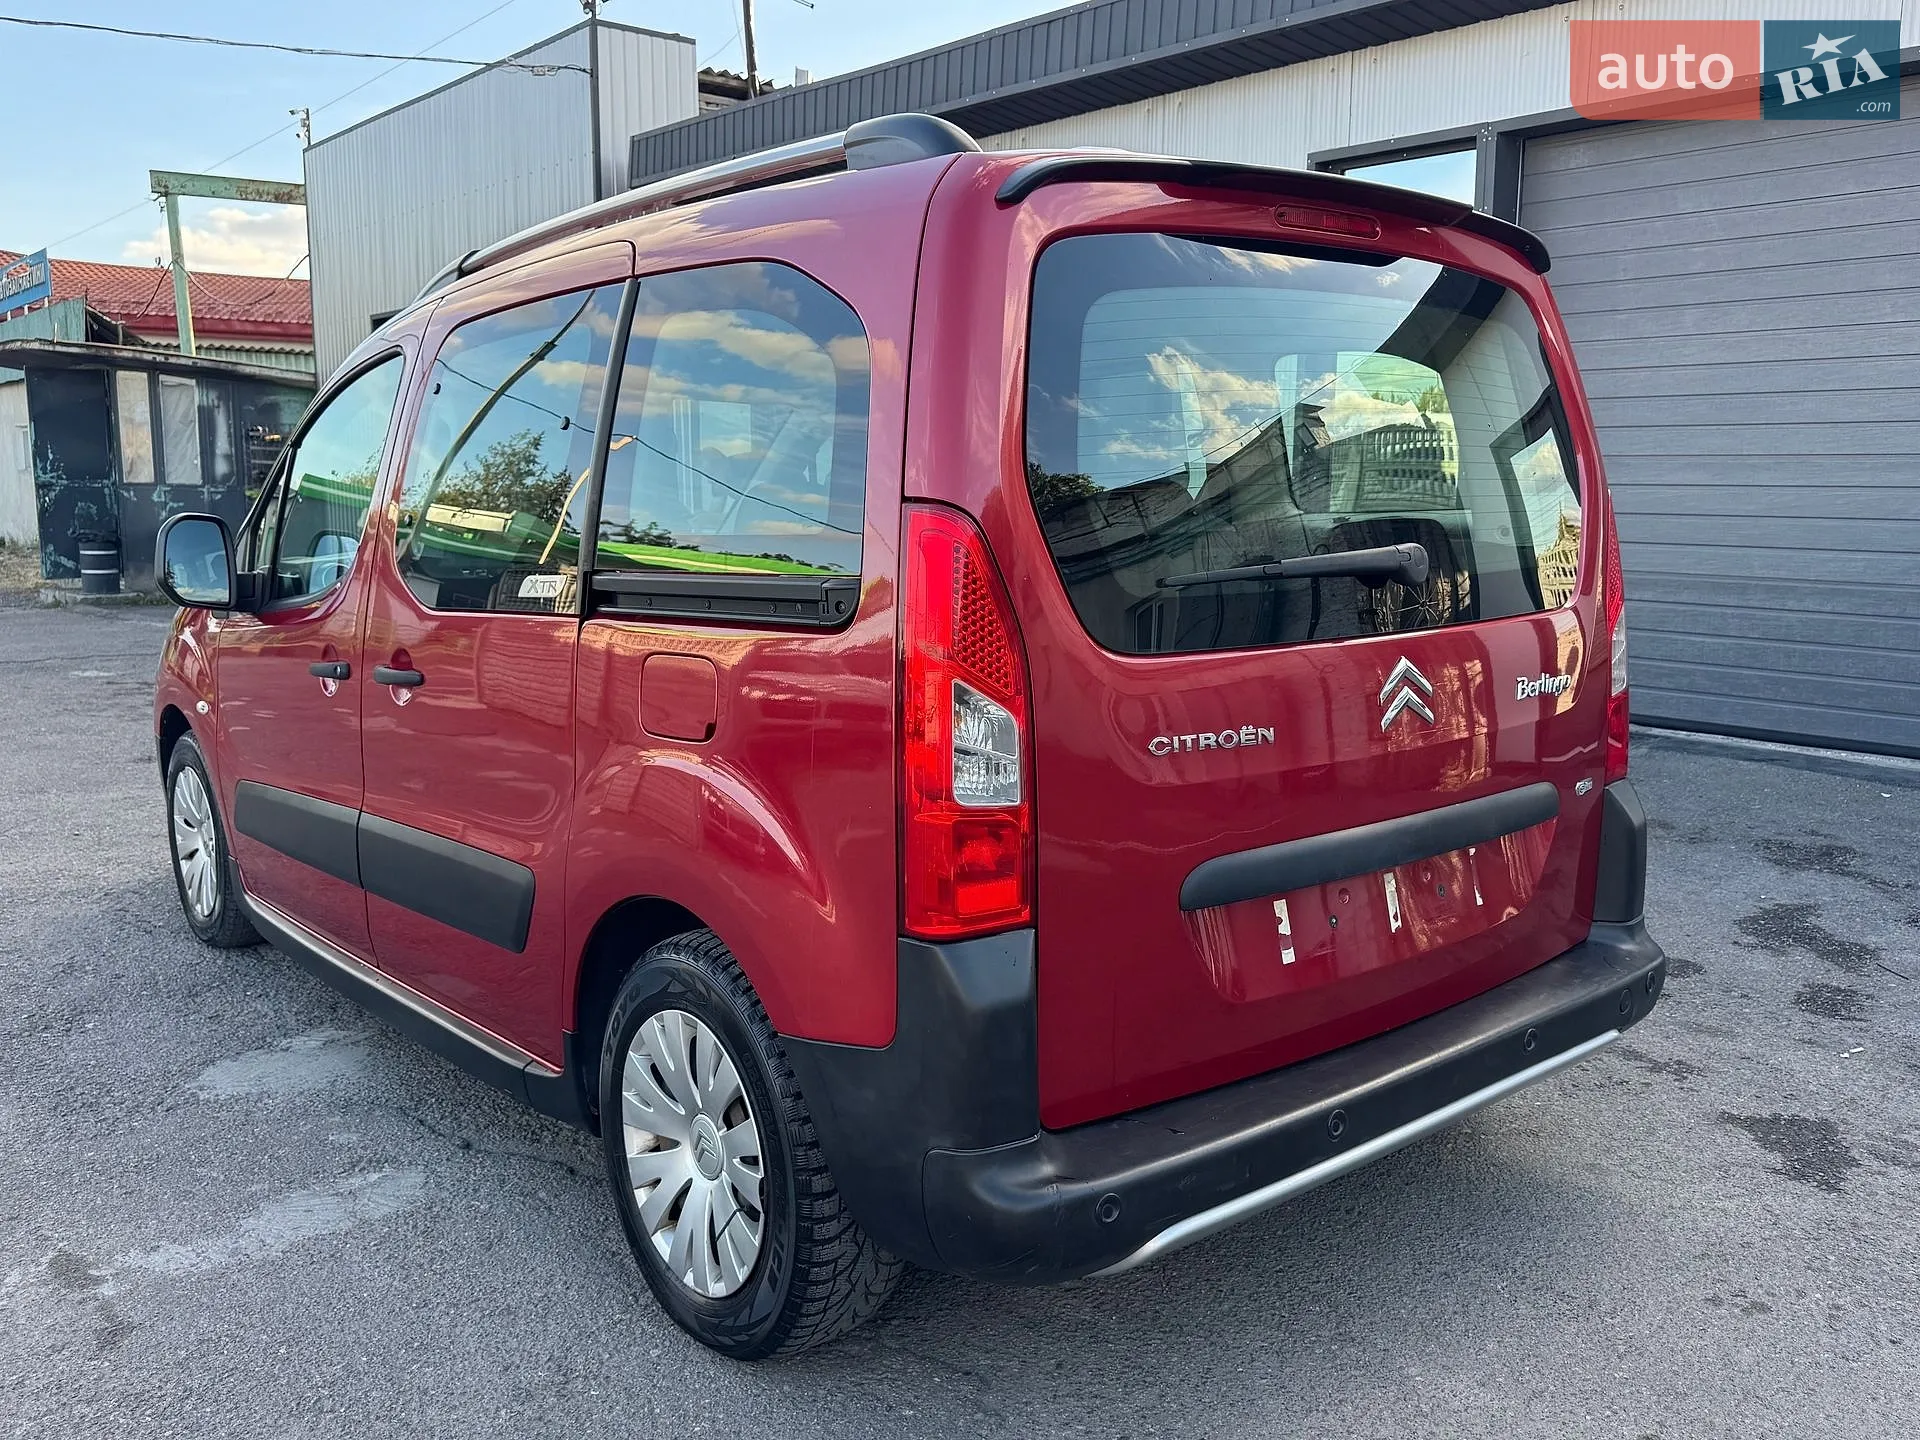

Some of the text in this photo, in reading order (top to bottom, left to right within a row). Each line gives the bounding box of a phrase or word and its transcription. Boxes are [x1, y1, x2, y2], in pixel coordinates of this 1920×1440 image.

[527, 579, 558, 594] XTR
[1516, 672, 1571, 701] Berlingo
[1147, 725, 1275, 756] CITROËN
[604, 983, 641, 1059] TOYO
